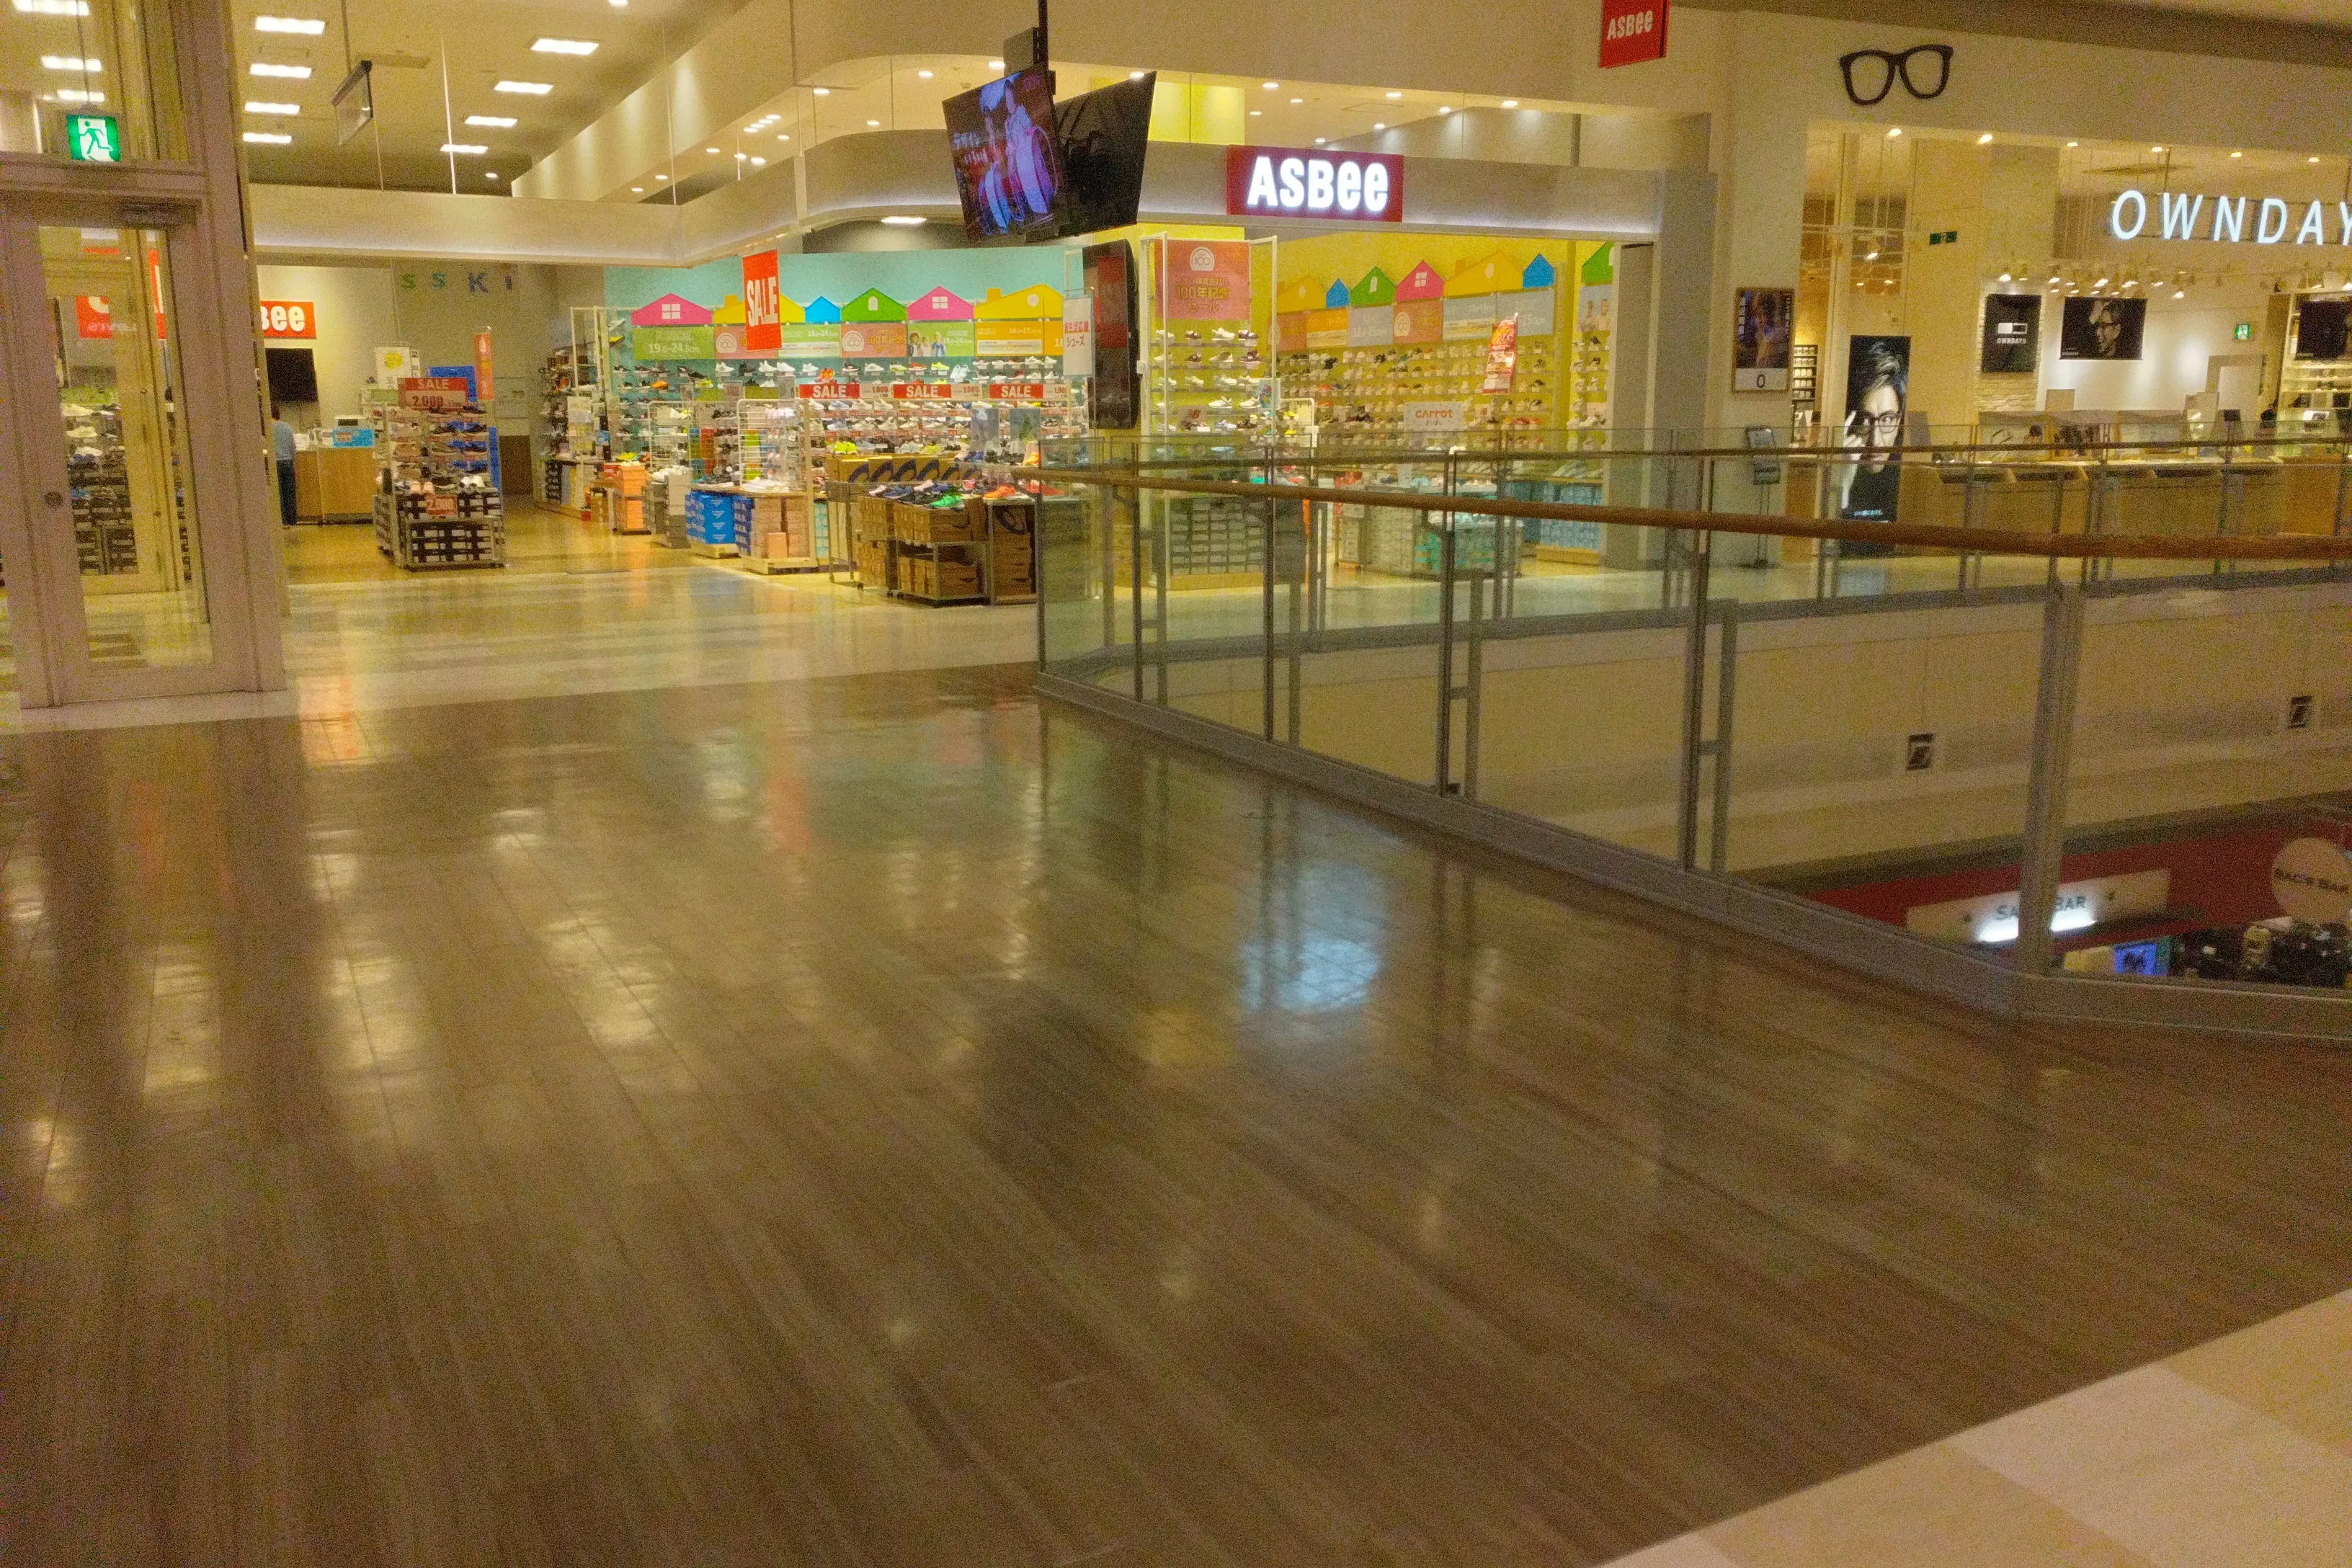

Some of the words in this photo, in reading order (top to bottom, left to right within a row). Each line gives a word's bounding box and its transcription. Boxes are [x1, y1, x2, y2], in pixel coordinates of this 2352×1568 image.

[1247, 156, 1389, 212] ASBee
[747, 276, 778, 327] SALE
[417, 378, 449, 390] SALE
[813, 385, 847, 398] SALE
[906, 385, 938, 398] SALE
[1001, 385, 1031, 398] SALE
